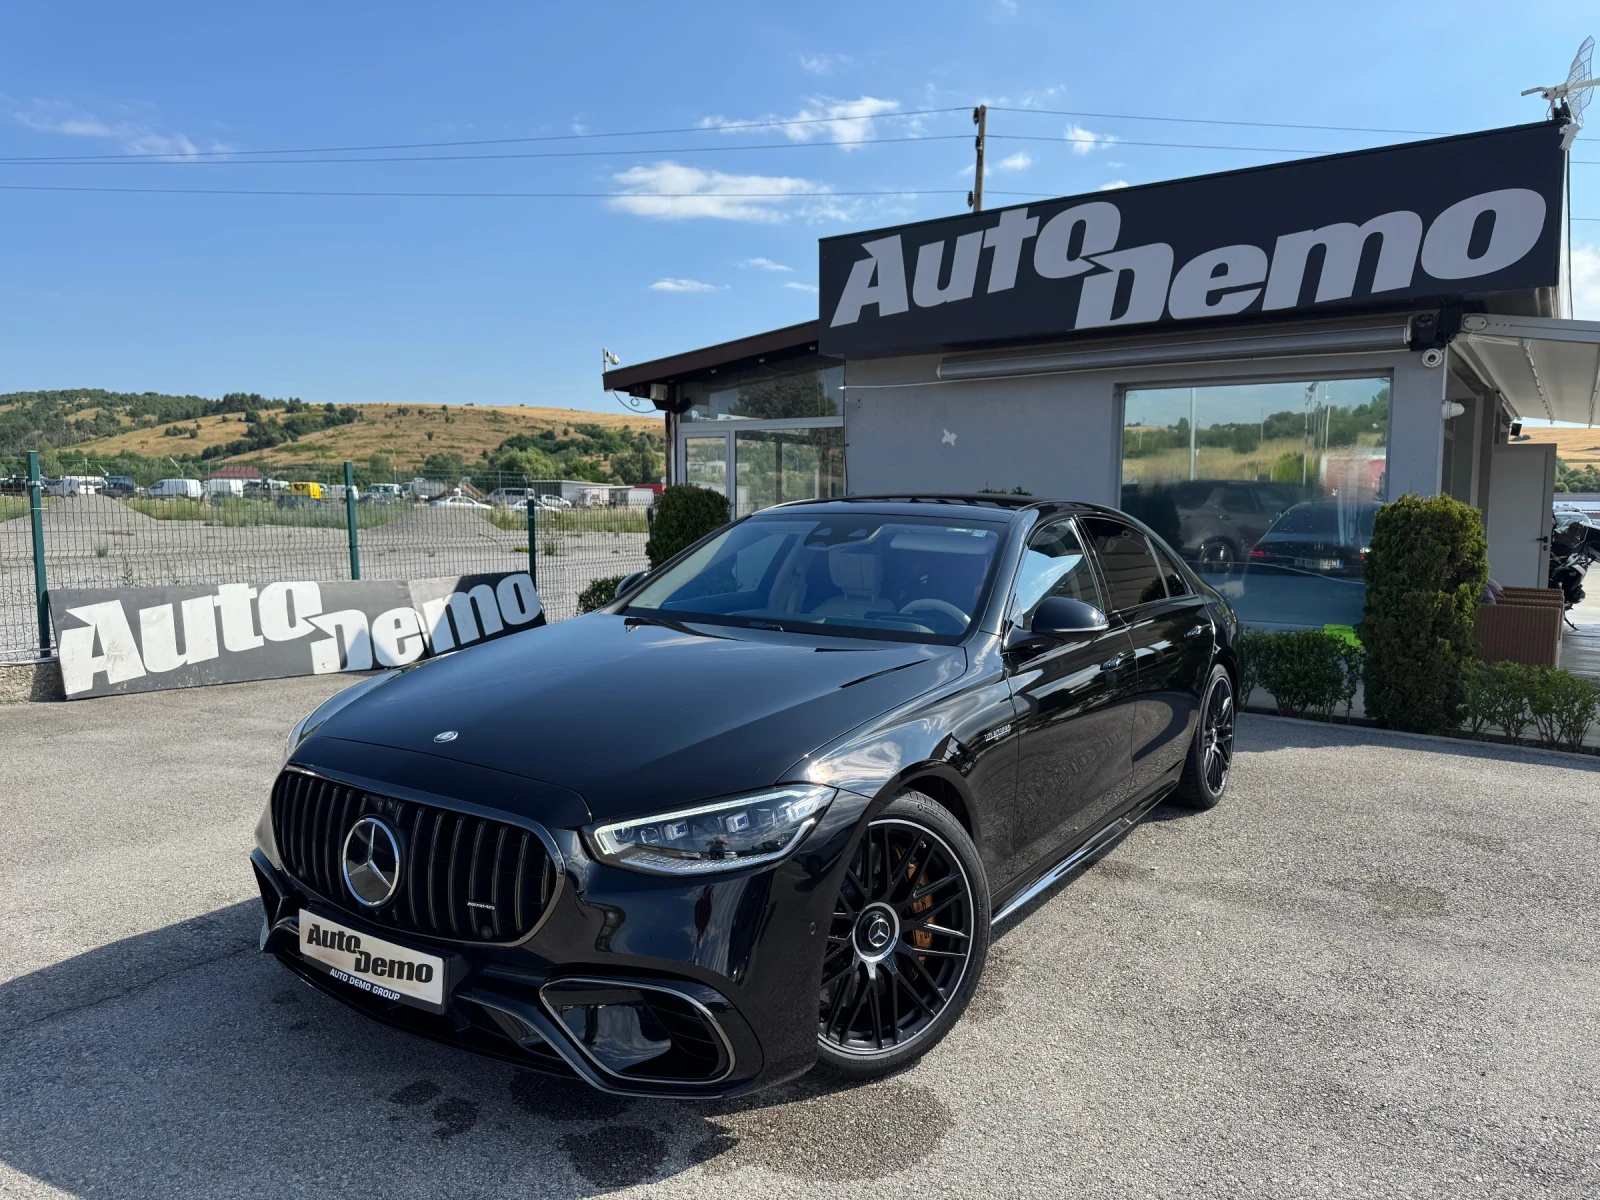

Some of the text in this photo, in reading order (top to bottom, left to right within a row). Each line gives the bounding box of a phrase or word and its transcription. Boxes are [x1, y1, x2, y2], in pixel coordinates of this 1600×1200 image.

[830, 189, 1546, 331] Auto Demo
[59, 573, 543, 696] Auto Demo
[307, 923, 434, 983] Auto Demo
[330, 968, 401, 1001] AUTO DEMO GROUP
